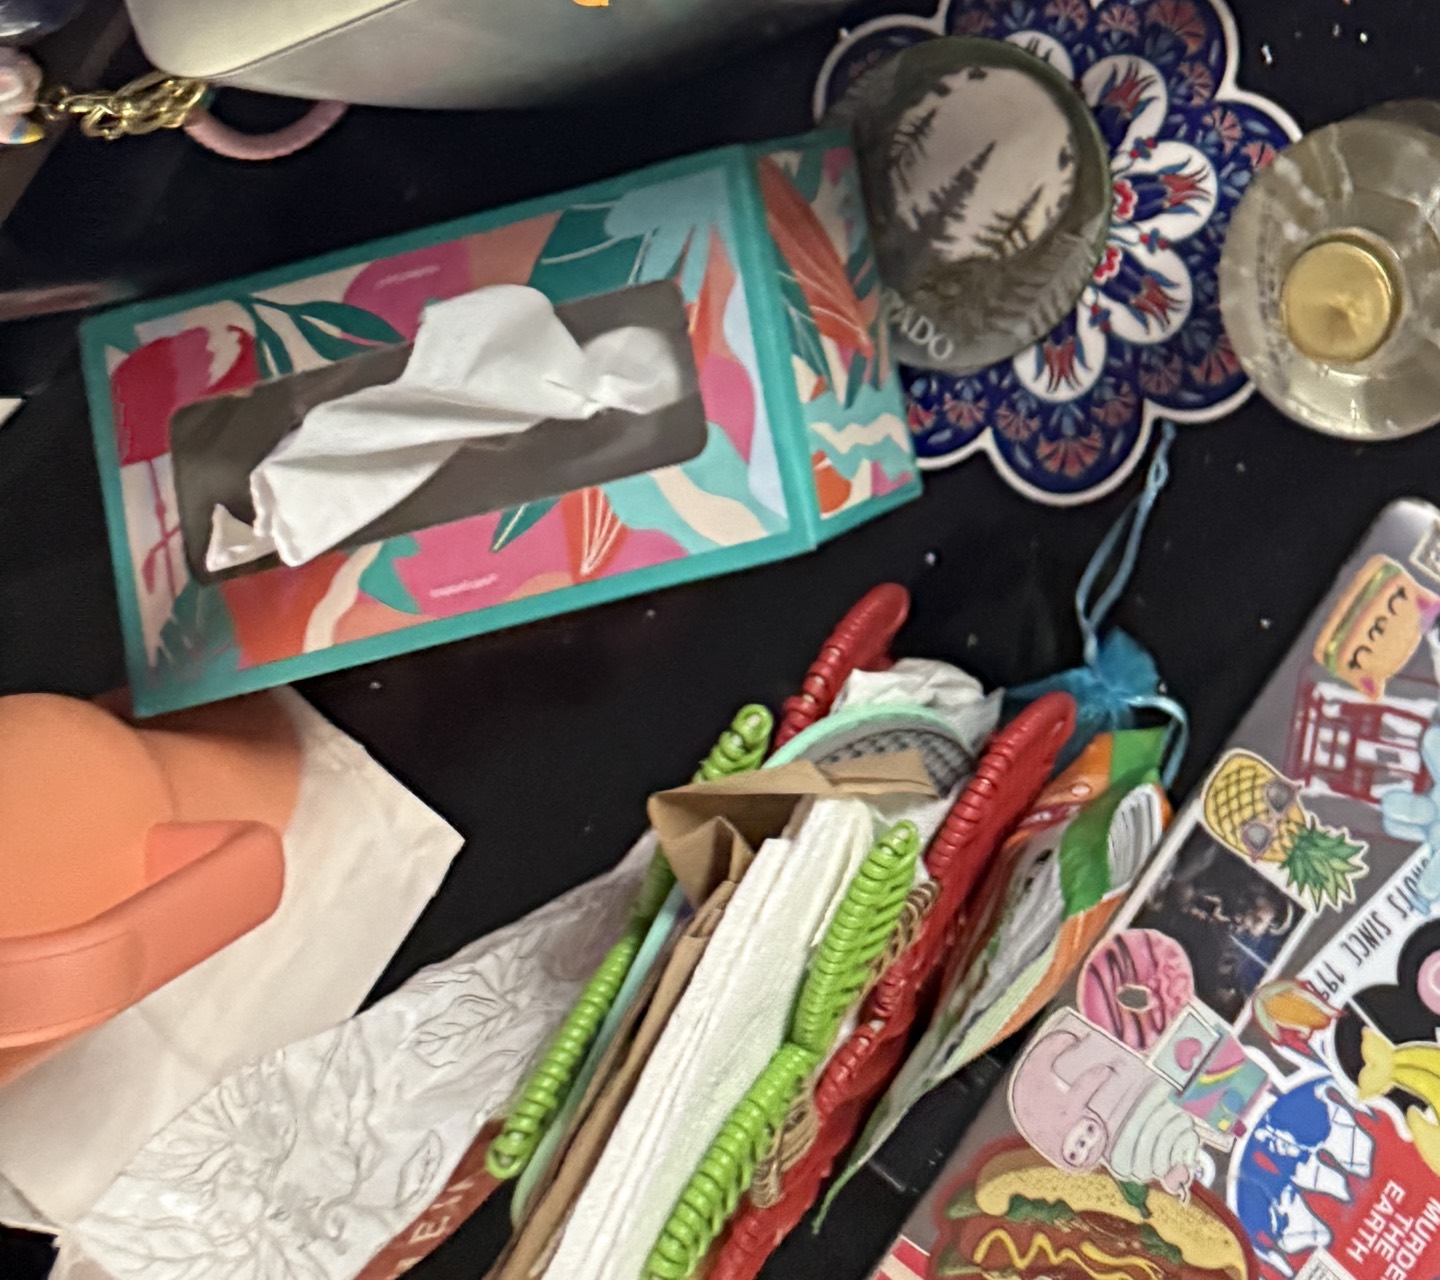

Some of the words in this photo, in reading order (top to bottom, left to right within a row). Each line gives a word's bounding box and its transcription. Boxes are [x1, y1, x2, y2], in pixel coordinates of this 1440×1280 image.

[1340, 910, 1392, 967] SINCE
[1345, 1179, 1406, 1264] EARTH
[1373, 1212, 1414, 1262] THE
